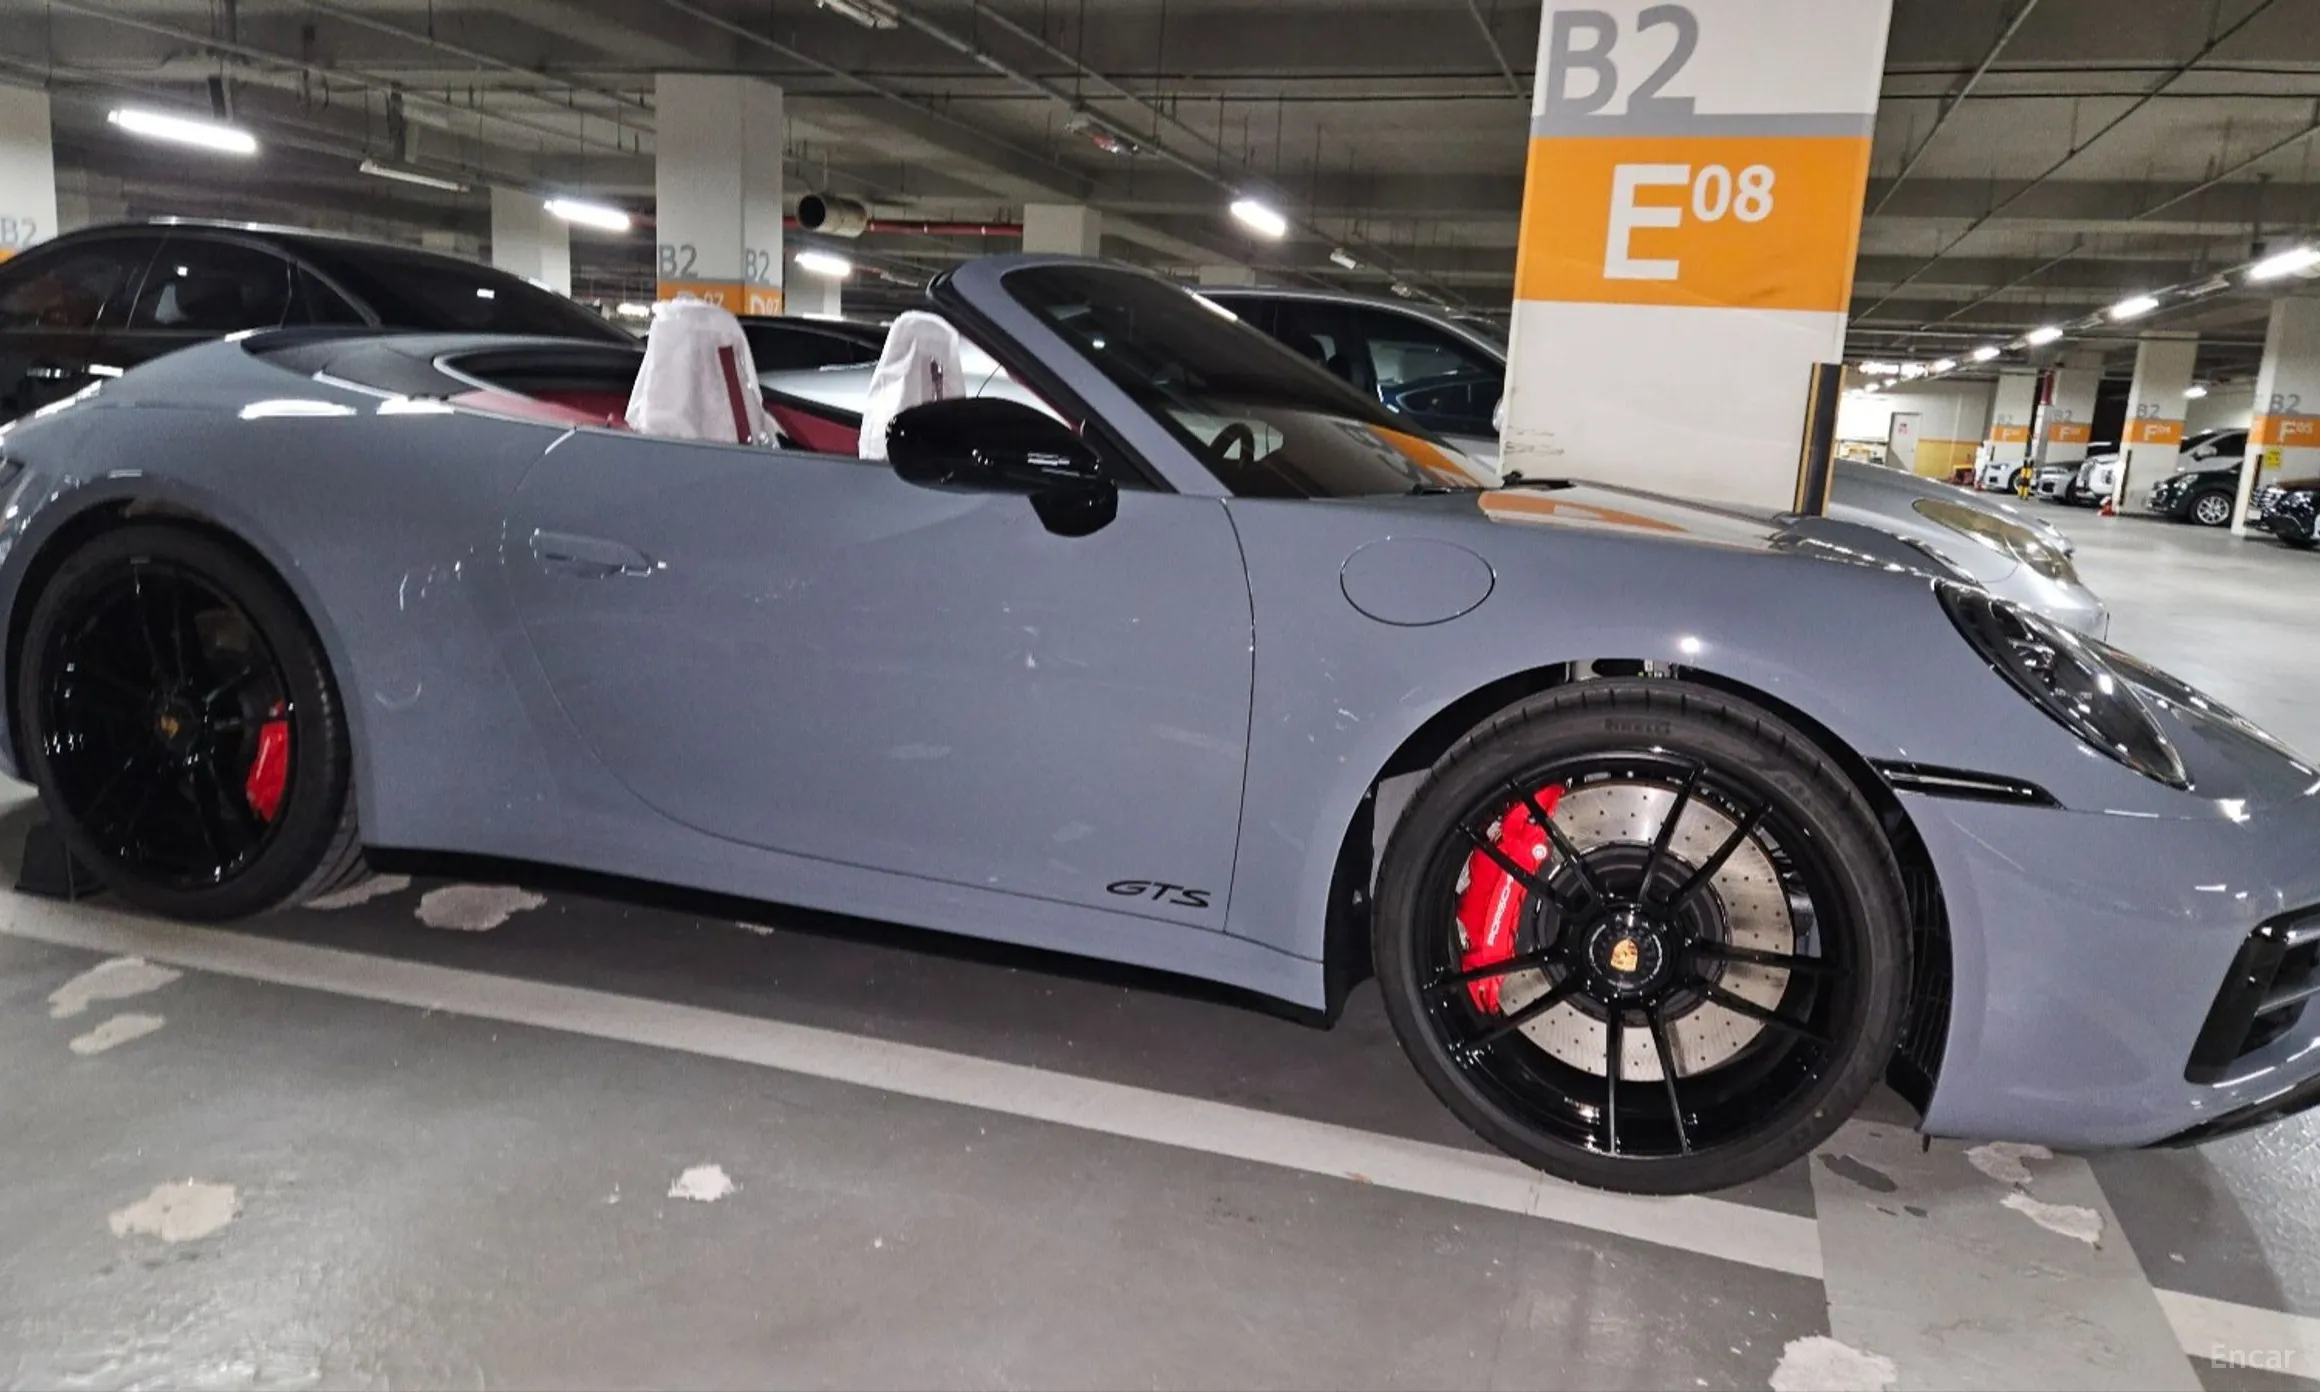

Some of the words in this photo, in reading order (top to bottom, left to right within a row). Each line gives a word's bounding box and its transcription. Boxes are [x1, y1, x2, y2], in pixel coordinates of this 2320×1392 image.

[1543, 4, 1698, 116] B2
[1, 216, 37, 250] B2
[1603, 163, 1775, 280] E08
[659, 244, 699, 279] B2
[745, 248, 770, 286] B2
[2136, 404, 2160, 419] B2
[2269, 393, 2302, 415] B2
[1106, 880, 1211, 909] GTS
[1486, 873, 1515, 947] PORSCH
